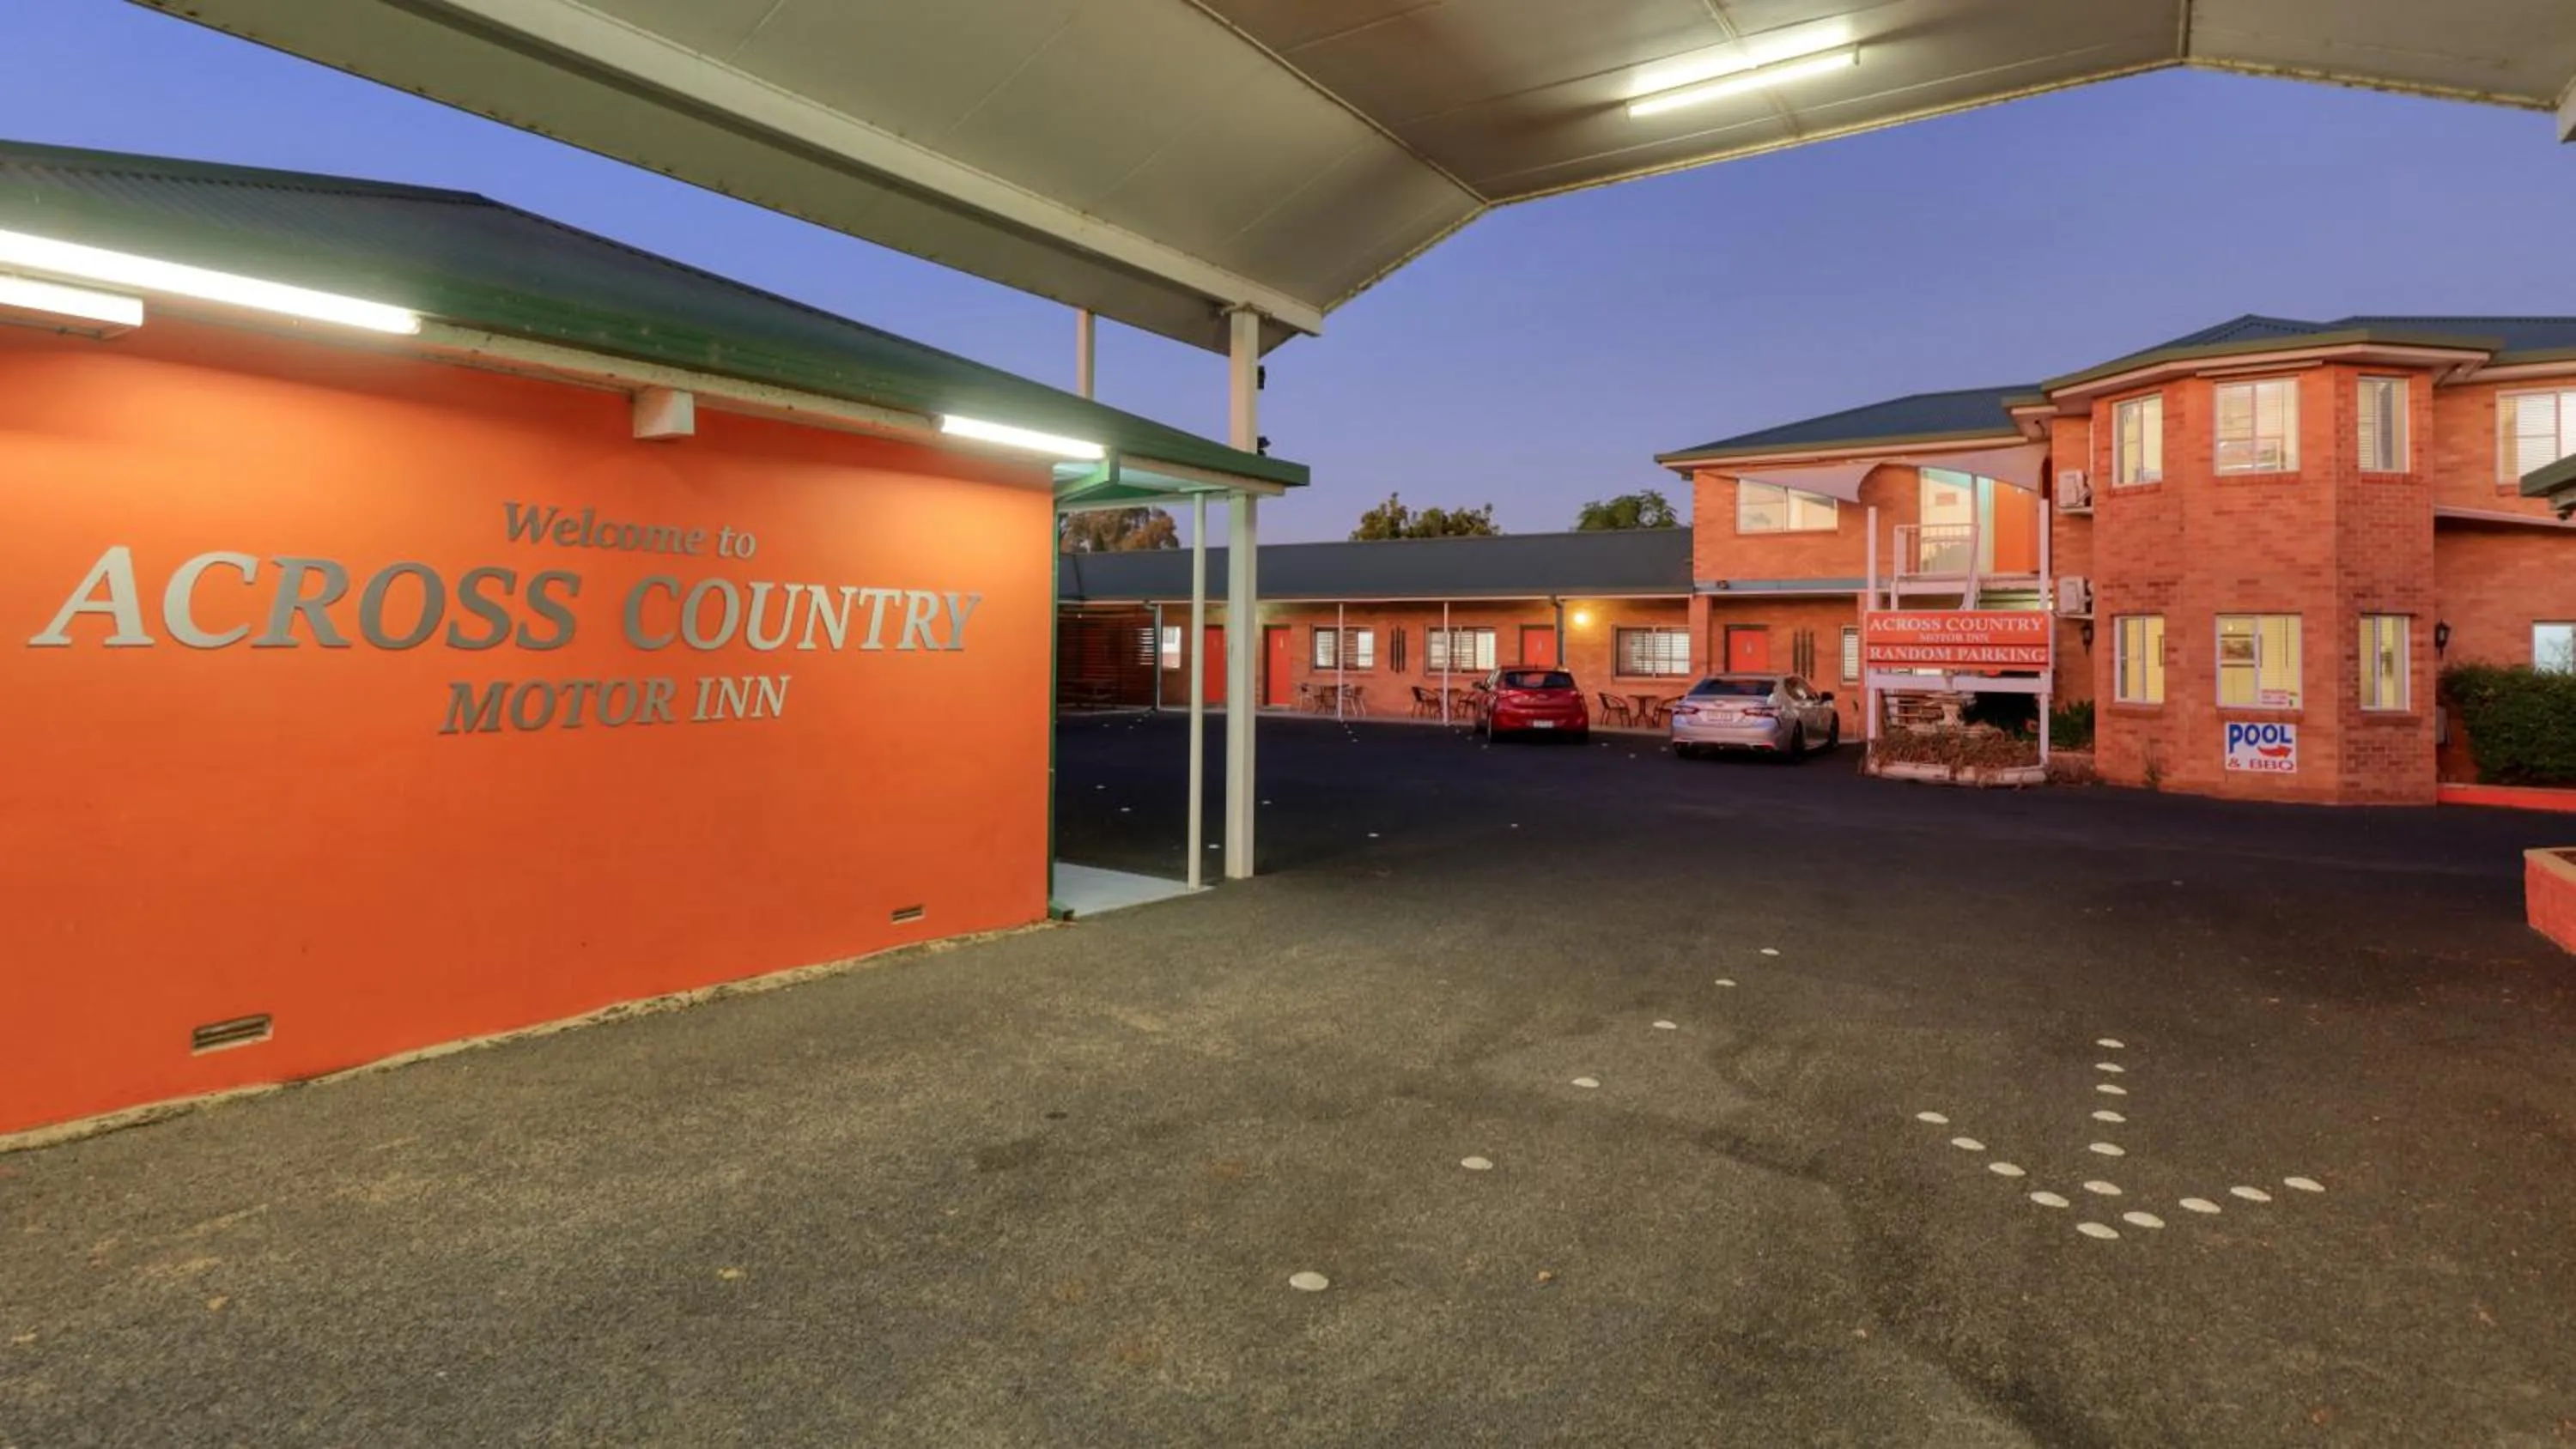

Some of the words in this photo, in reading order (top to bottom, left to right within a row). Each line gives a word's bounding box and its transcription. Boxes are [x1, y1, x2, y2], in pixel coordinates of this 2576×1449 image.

[503, 502, 705, 555] Welcome
[717, 525, 756, 559] to
[26, 546, 582, 651] ACROSS
[623, 576, 982, 652] COUNTRY
[1869, 617, 1941, 632] ACROSS
[1946, 617, 2043, 632] COUNTRY
[1919, 633, 1964, 643] MOTOR
[1965, 633, 1990, 643] INN
[1869, 646, 1950, 661] RANDOM
[1957, 647, 2046, 662] PARKING
[439, 678, 676, 734] MOTOR
[691, 676, 790, 722] INN
[2228, 724, 2293, 754] POOL
[2228, 757, 2240, 767] &
[2250, 759, 2293, 770] BBQ
